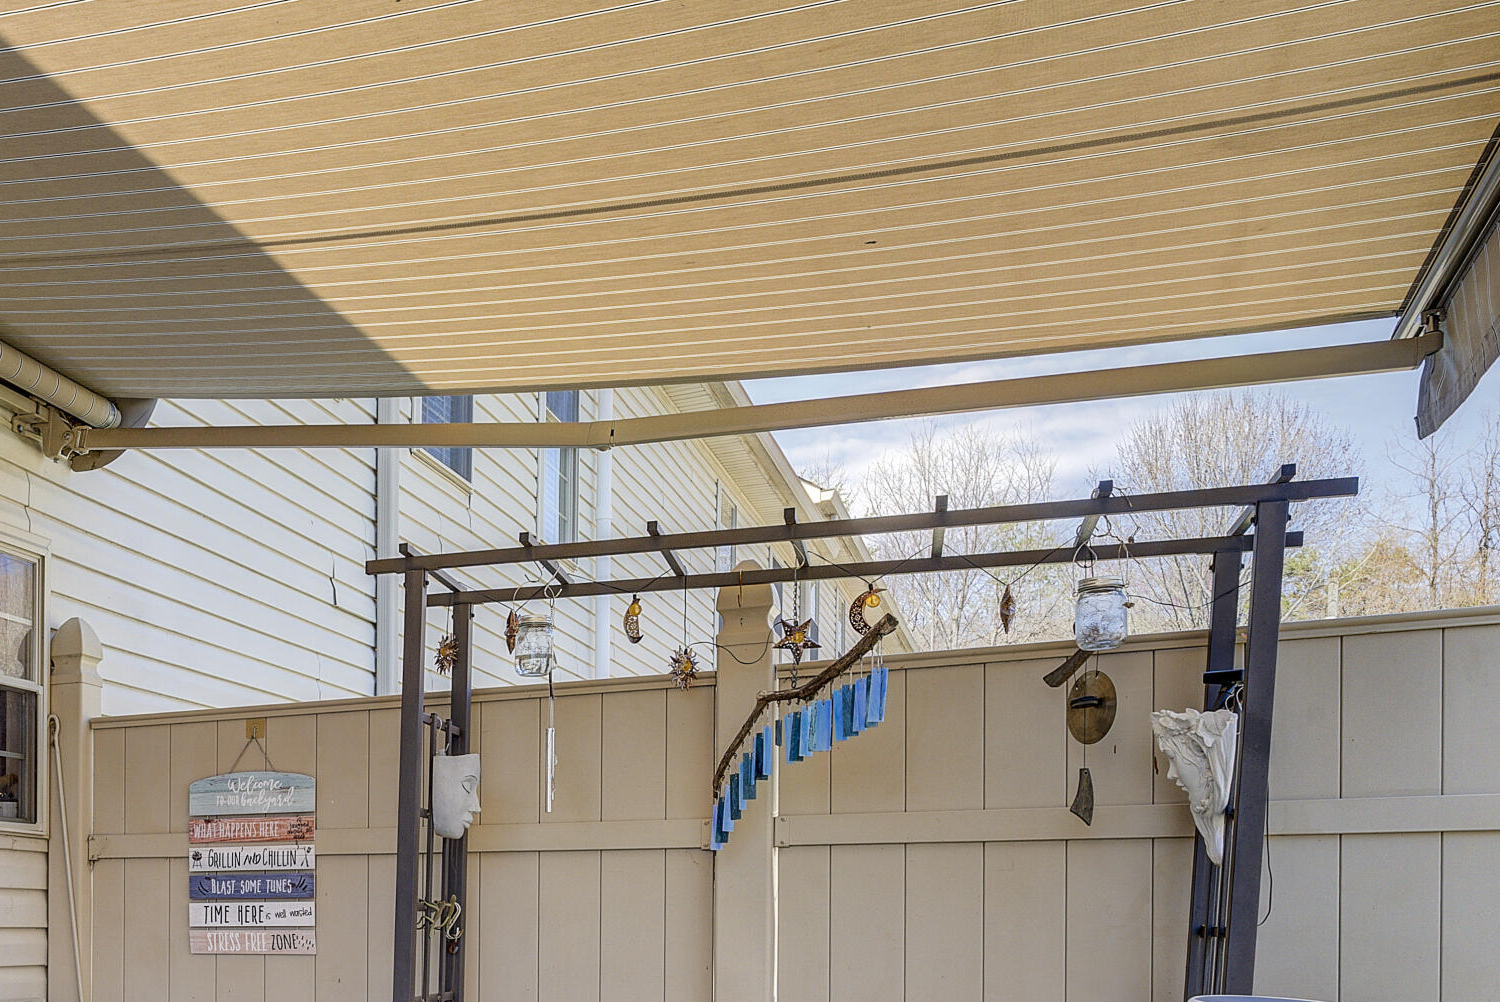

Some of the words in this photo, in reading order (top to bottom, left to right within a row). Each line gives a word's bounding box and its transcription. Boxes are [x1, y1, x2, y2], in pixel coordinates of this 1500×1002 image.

[227, 775, 282, 795] Welcome
[240, 786, 295, 813] backyard
[193, 822, 217, 839] WHAT
[219, 821, 257, 838] HAPPENS
[259, 820, 280, 837] HERE
[211, 878, 236, 895] BLAST
[240, 879, 262, 895] SOME
[266, 879, 292, 894] TUNES
[203, 905, 230, 925] TIME
[238, 904, 265, 925] HERE
[274, 909, 287, 919] well
[289, 906, 313, 918] wasted
[207, 932, 241, 952] STRESS
[244, 931, 268, 952] FREE
[271, 933, 298, 951] ZONE
